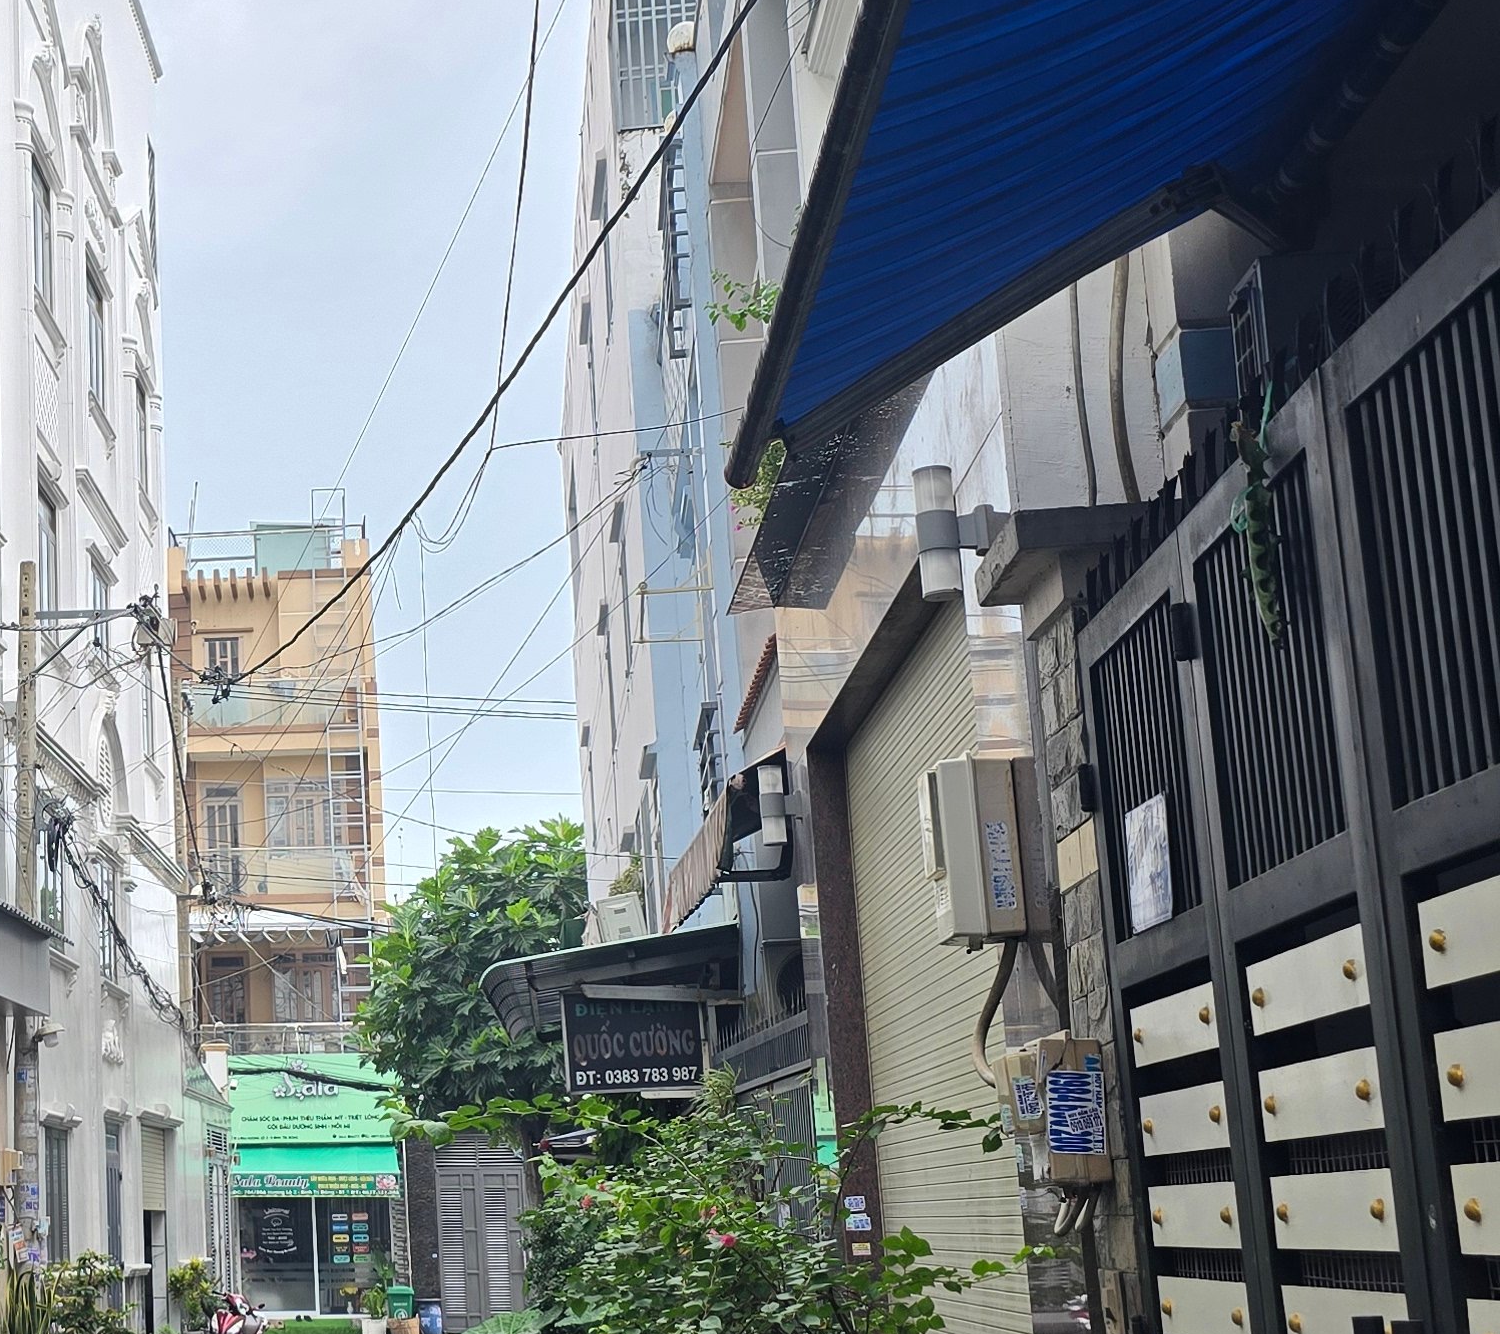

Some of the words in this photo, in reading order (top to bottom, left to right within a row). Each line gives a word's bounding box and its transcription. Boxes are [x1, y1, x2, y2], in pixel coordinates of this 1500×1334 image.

[575, 1003, 623, 1018] ĐIỆN
[572, 1020, 625, 1066] QUỐC
[629, 1022, 695, 1057] CƯỜNG
[575, 1070, 602, 1085] ĐT:
[605, 1068, 639, 1084] 0383
[643, 1067, 668, 1083] 783
[672, 1066, 697, 1081] 987
[232, 1174, 262, 1188] Sala
[264, 1175, 311, 1190] Beauty
